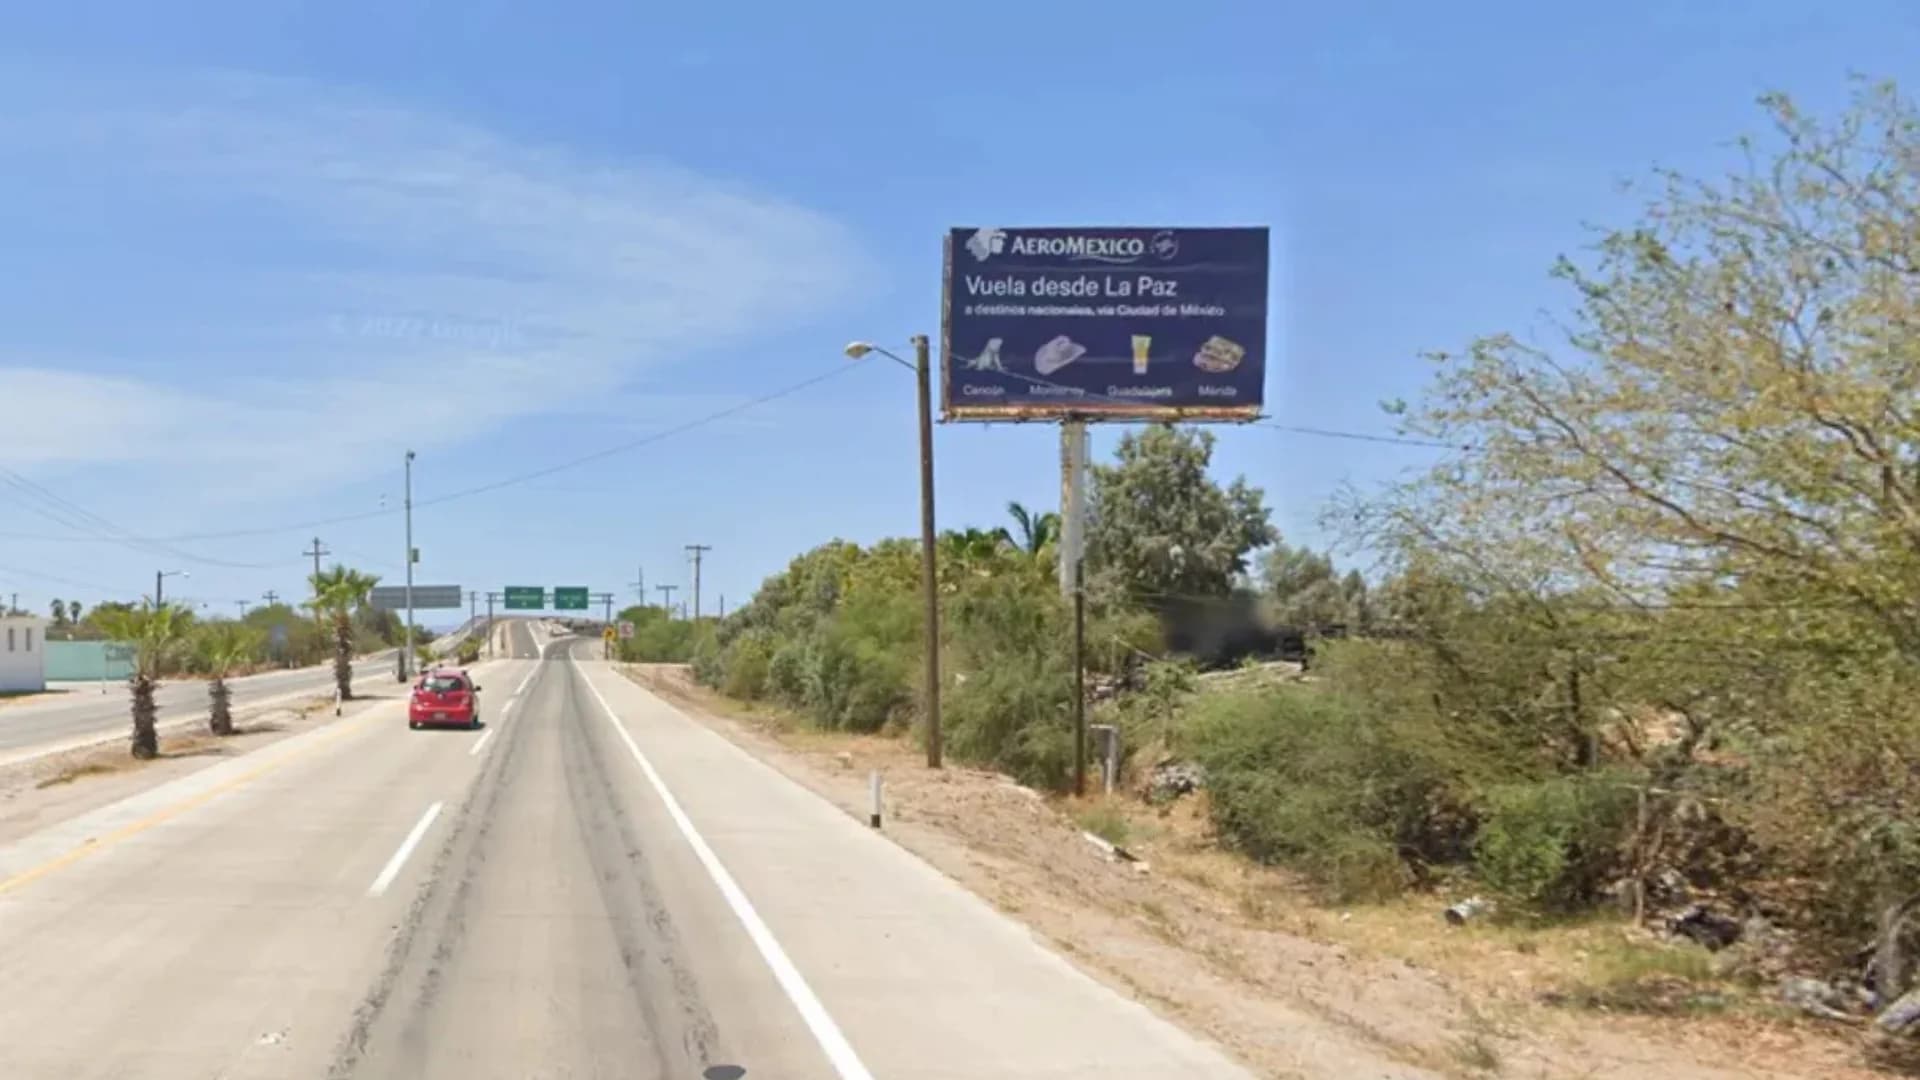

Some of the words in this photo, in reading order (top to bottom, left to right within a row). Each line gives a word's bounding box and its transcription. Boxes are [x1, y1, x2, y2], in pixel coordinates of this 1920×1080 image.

[966, 275, 1025, 296] Vuela
[1032, 276, 1098, 296] desde
[1105, 276, 1131, 296] La
[1139, 276, 1177, 296] Paz
[975, 304, 1025, 316] destinos
[1117, 304, 1160, 316] Ciudad
[1162, 304, 1177, 316] de
